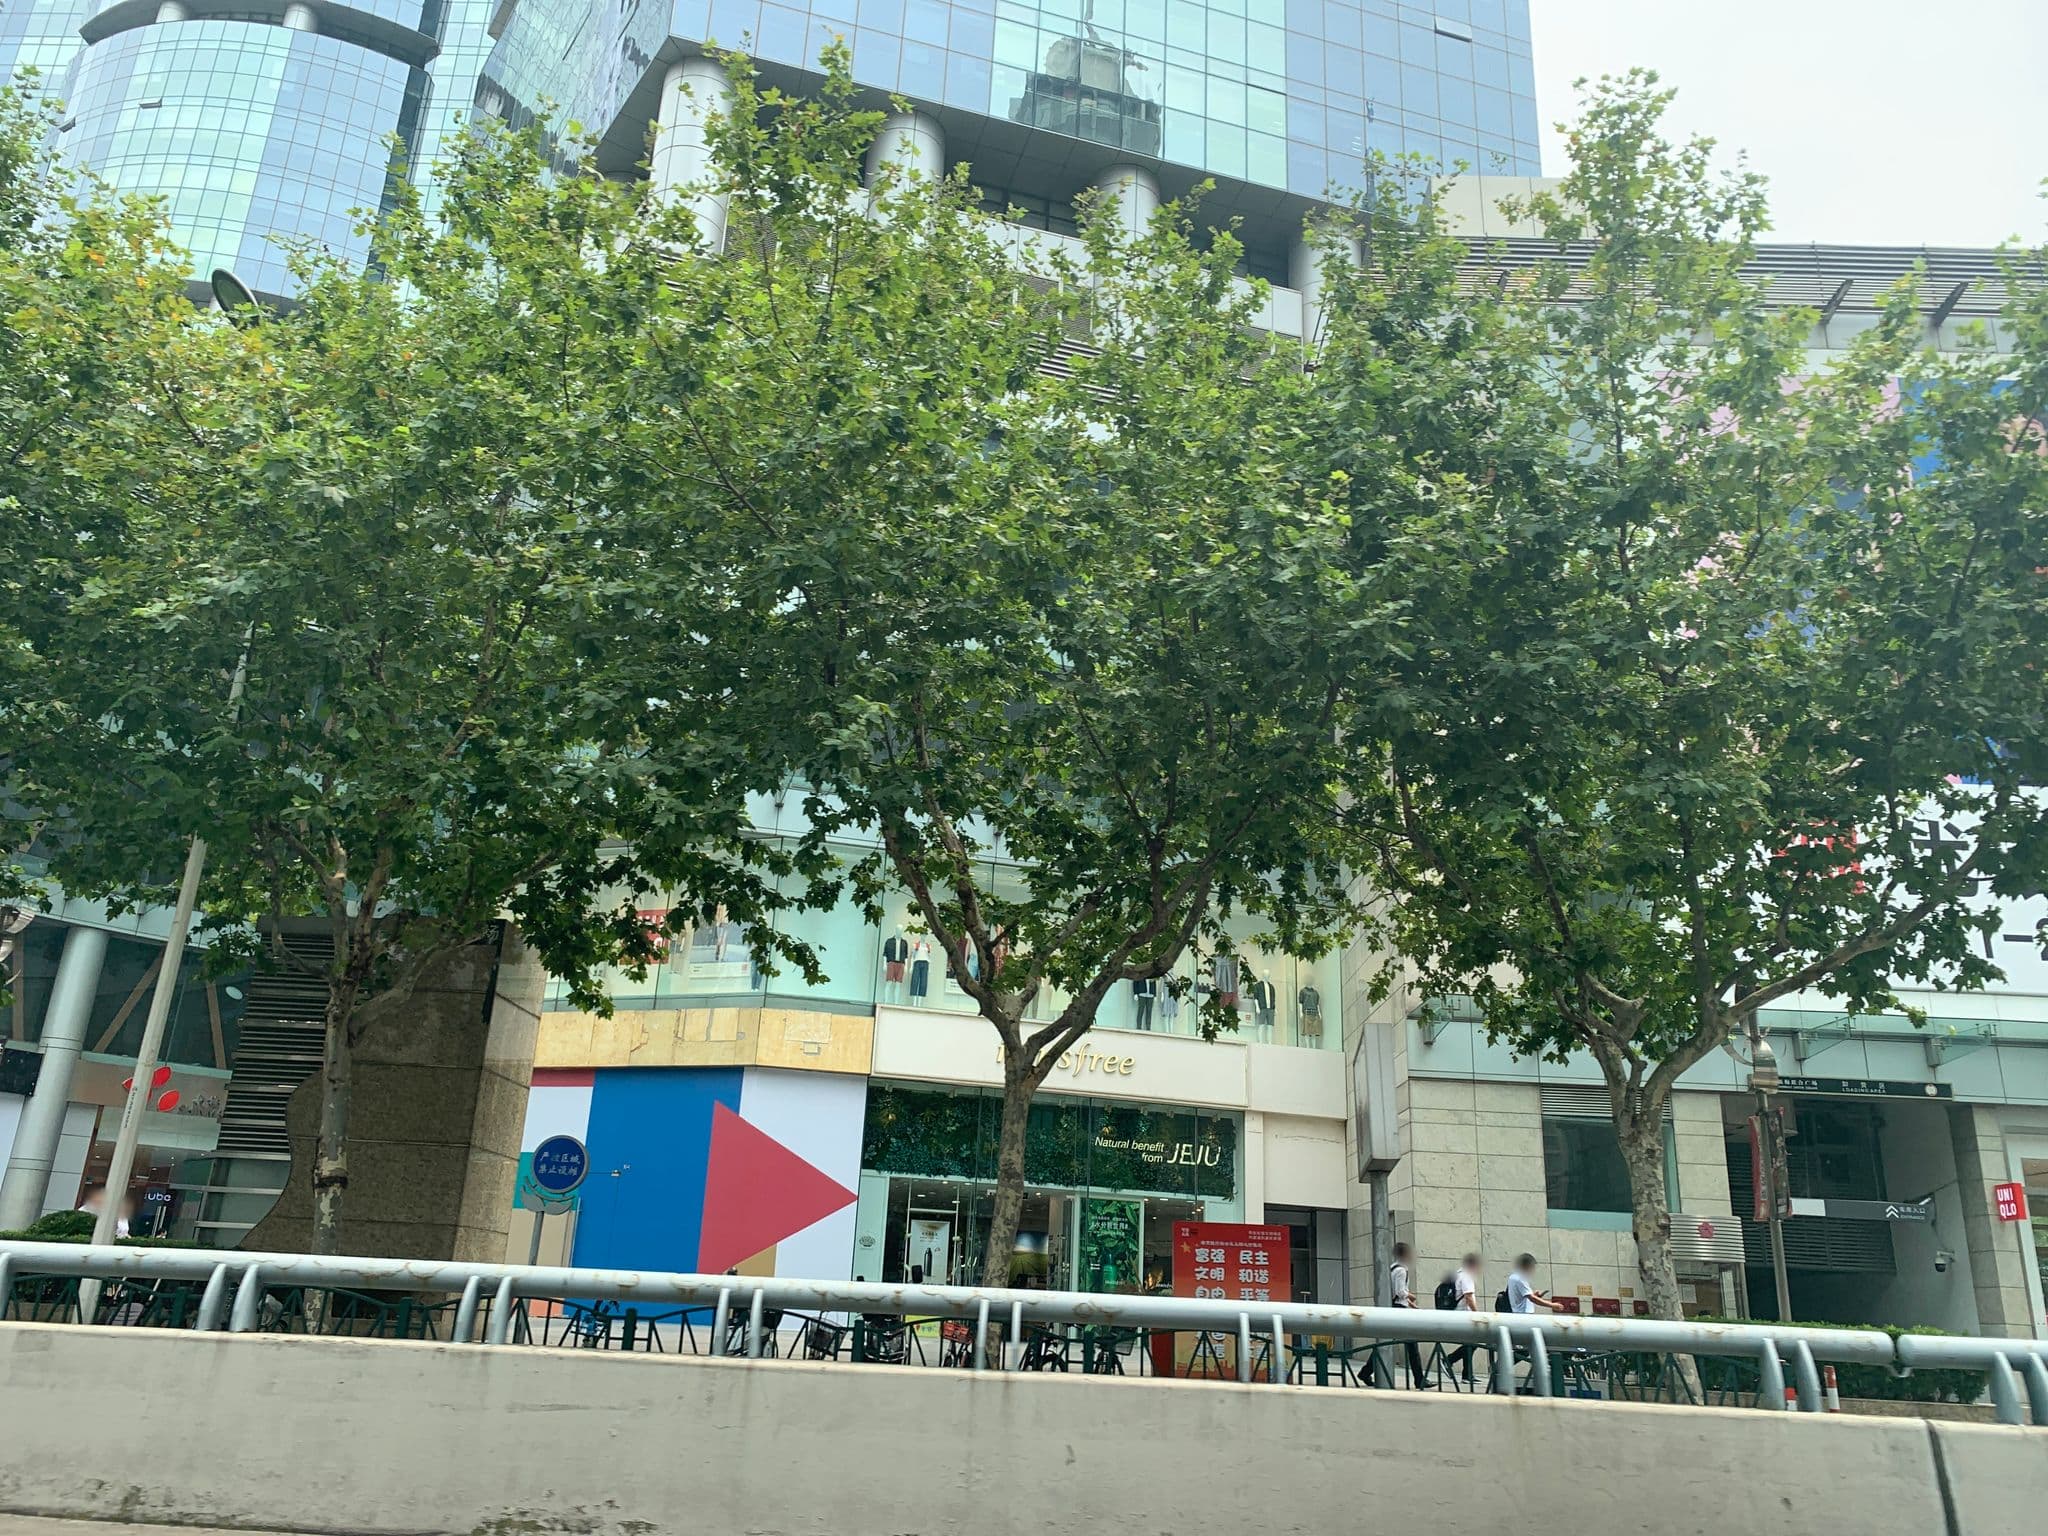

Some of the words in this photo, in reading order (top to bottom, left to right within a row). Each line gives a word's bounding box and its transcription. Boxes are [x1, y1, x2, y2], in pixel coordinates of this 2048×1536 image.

[1094, 1136, 1129, 1149] Natural
[1131, 1140, 1164, 1153] benefit
[1141, 1152, 1163, 1163] from
[1166, 1142, 1221, 1167] JEJU
[1996, 1187, 2014, 1202] UNI
[1999, 1203, 2017, 1219] QLO
[1194, 1247, 1226, 1264] 富强
[1239, 1249, 1270, 1266] 民主
[1194, 1266, 1226, 1281] 文明
[1238, 1268, 1270, 1284] 和谐
